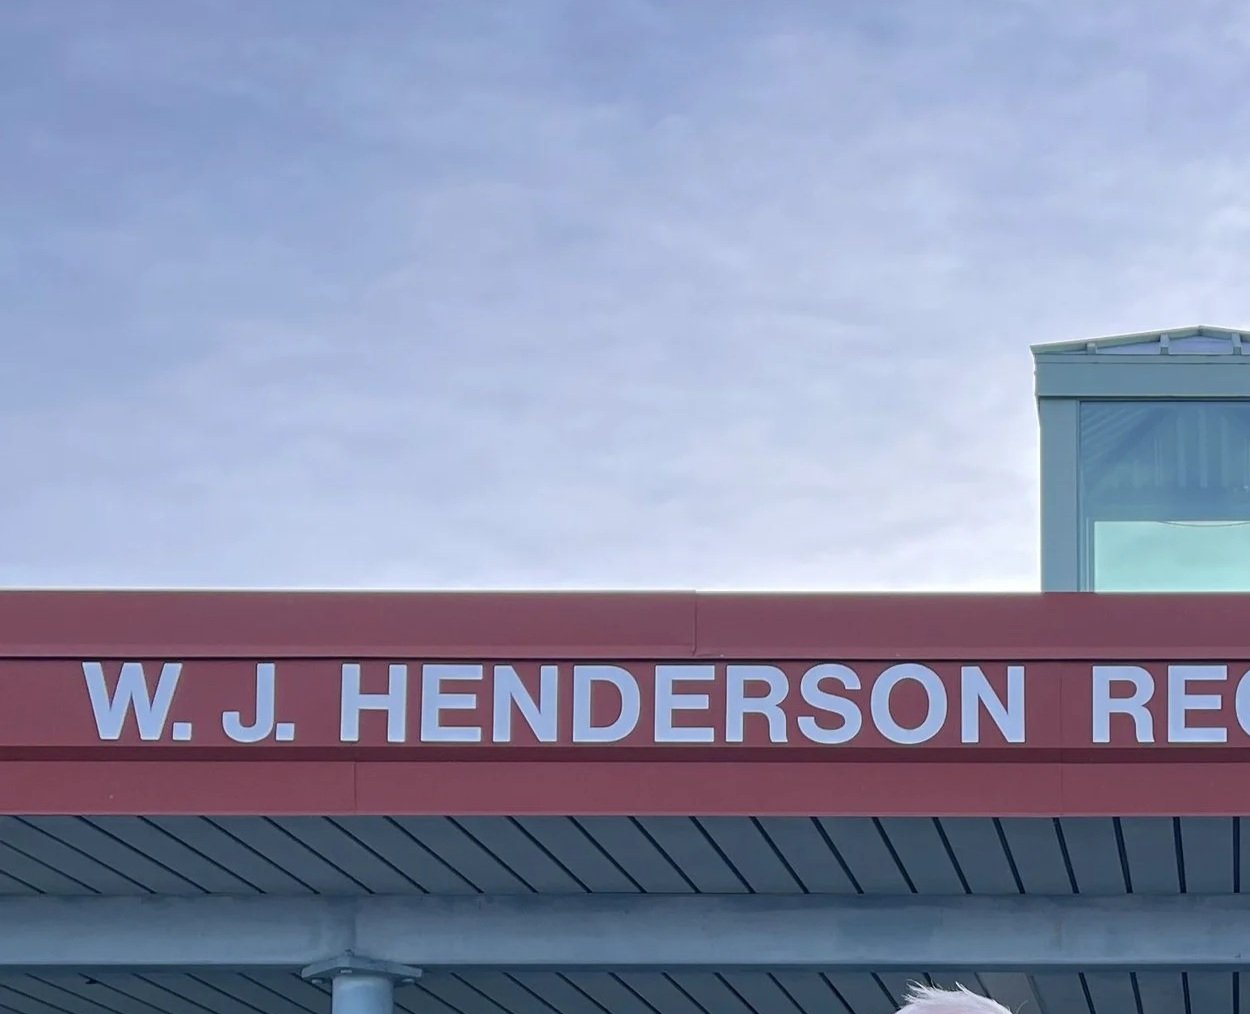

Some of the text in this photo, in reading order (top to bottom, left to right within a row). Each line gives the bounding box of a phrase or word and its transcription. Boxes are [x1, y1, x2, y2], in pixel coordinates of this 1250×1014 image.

[82, 661, 193, 741] W.
[222, 662, 295, 743] J.
[340, 663, 1026, 745] HENDERSON
